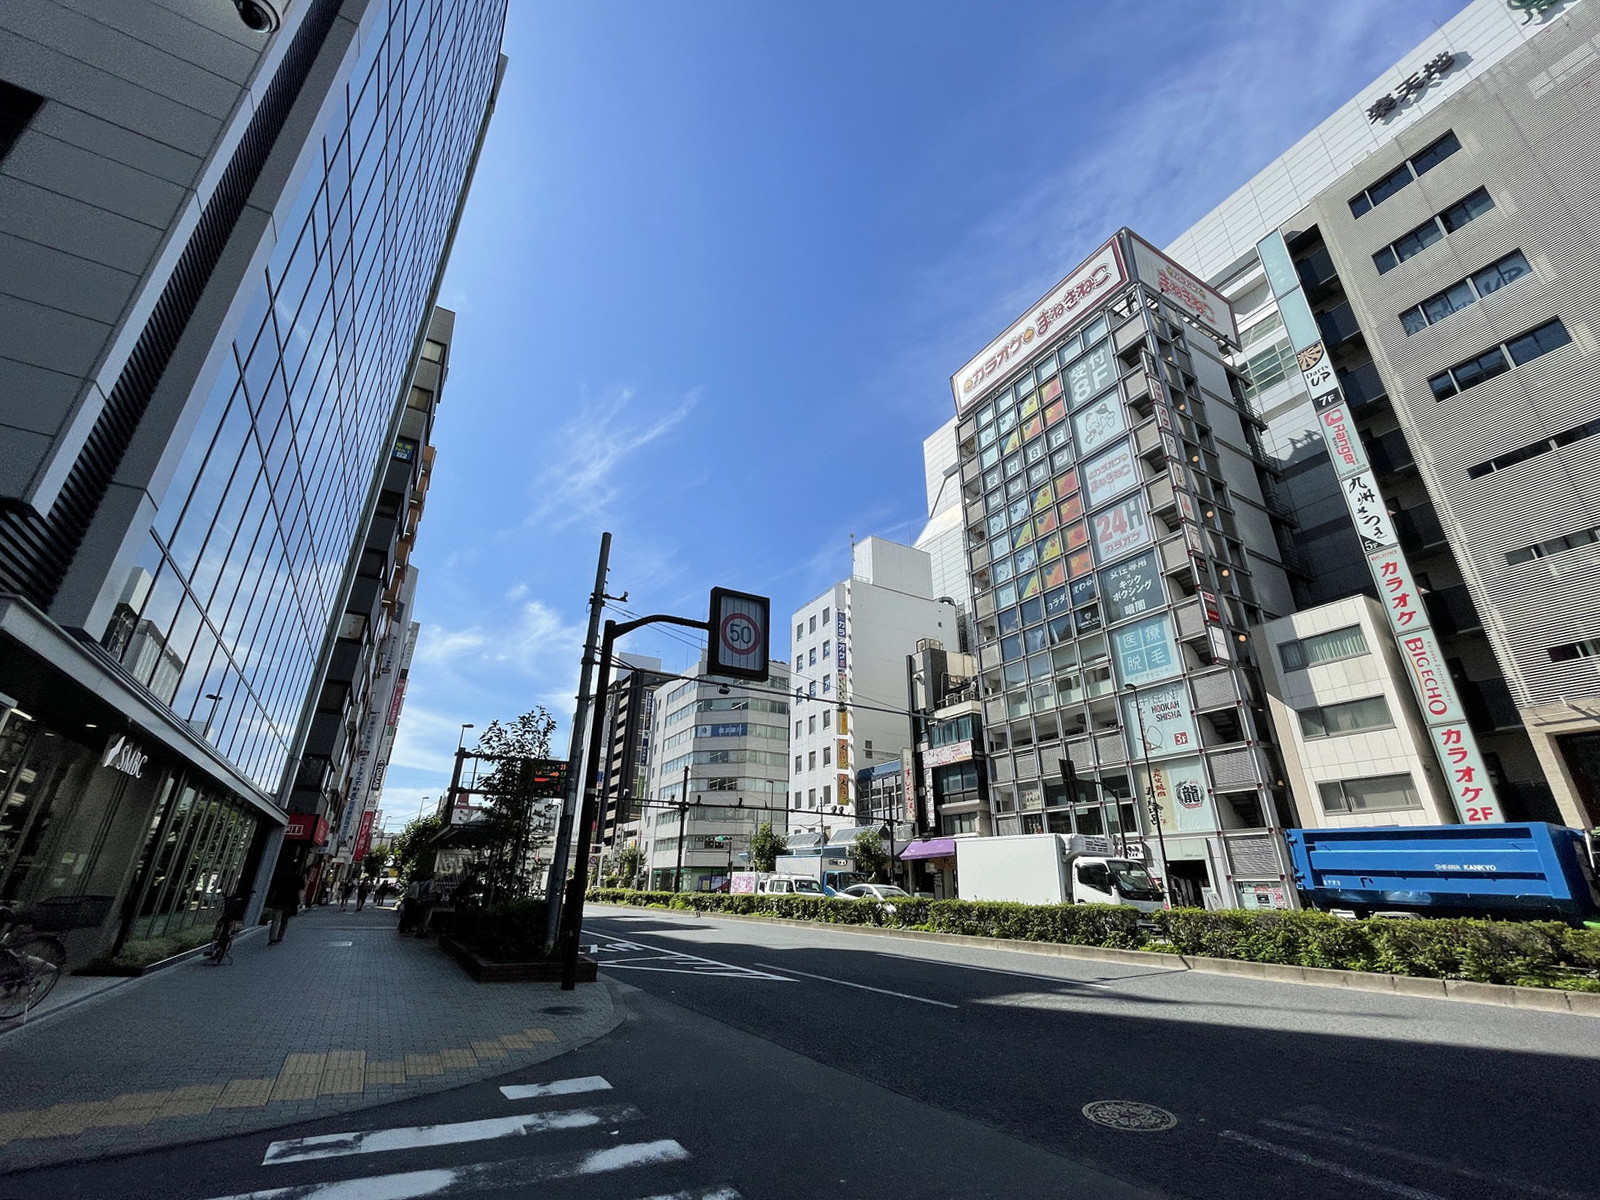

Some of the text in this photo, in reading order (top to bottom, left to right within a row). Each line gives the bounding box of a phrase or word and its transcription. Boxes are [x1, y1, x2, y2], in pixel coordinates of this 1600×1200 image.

[972, 263, 1111, 387] カラオケ まねきねこ
[1070, 348, 1105, 383] 受付
[1305, 365, 1329, 380] Darts
[1074, 363, 1108, 402] 8F
[1310, 371, 1331, 387] UP
[1319, 393, 1335, 406] 7F
[1096, 497, 1144, 544] 24H
[1104, 530, 1142, 554] カラオケ
[1110, 559, 1147, 580] 女性専用
[1113, 579, 1152, 602] ボクシング
[1120, 574, 1141, 589] キック
[1380, 562, 1416, 626] カラオケ
[1125, 599, 1146, 615] 暗闇
[730, 623, 752, 644] 50
[1123, 624, 1161, 649] 医療
[1127, 649, 1166, 672] 脱毛
[1404, 637, 1448, 716] BIG ECHO
[1150, 700, 1181, 714] HOOKAH
[1155, 710, 1183, 723] SHISHA
[1175, 733, 1188, 745] 3F
[116, 745, 149, 779] SMBC
[1441, 729, 1484, 803] カラオケ
[1181, 784, 1201, 804] 龍
[1466, 807, 1494, 822] 2F
[1434, 864, 1461, 872] SHINWA
